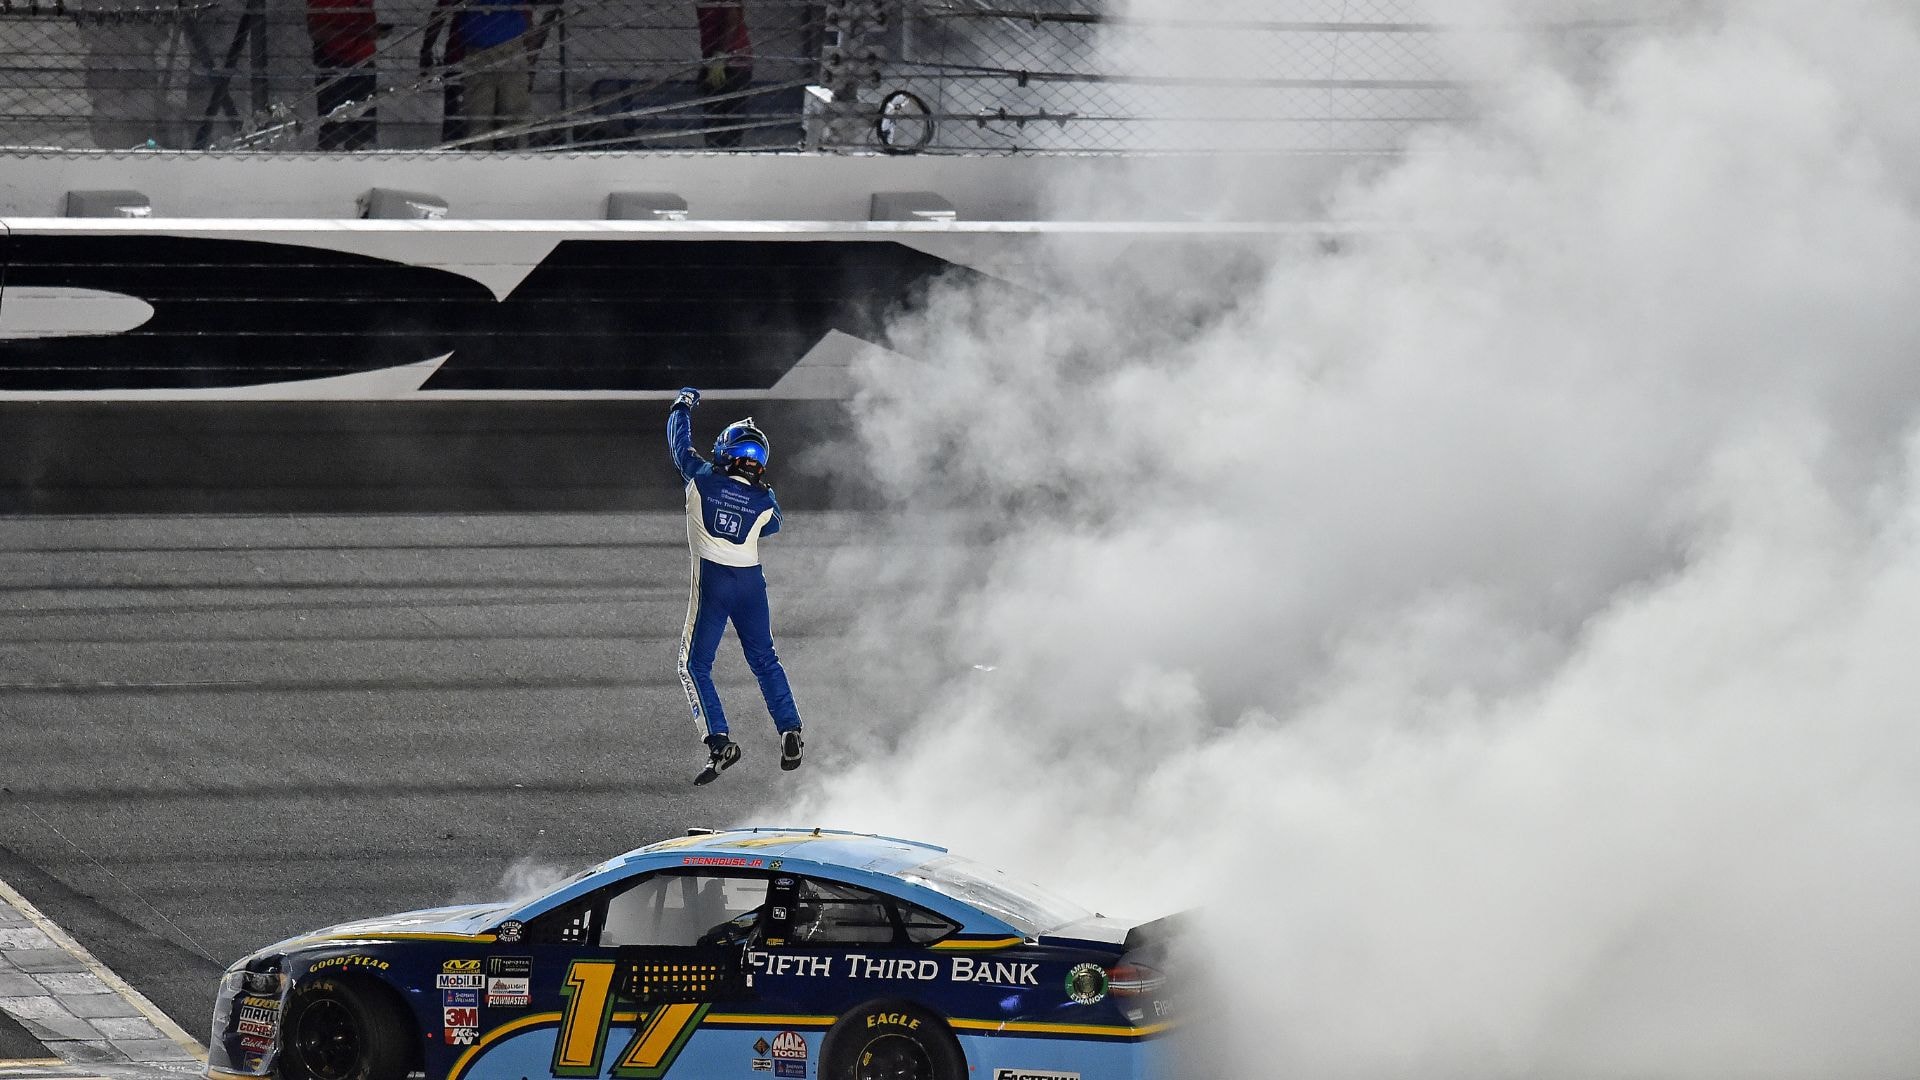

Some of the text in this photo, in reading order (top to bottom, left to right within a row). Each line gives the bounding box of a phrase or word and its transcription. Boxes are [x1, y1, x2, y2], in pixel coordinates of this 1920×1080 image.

[309, 954, 390, 973] GOODYEAR
[753, 952, 1039, 985] FIFTH THIRD BANK
[1070, 962, 1107, 978] AMERICAN
[440, 975, 470, 987] Mobil
[488, 996, 527, 1008] FLOWMASTER
[1070, 992, 1104, 1005] ETHANOL
[445, 1008, 477, 1026] 3M
[867, 1013, 921, 1030] EAGLE
[773, 1032, 806, 1051] MAC
[773, 1050, 806, 1058] TOOLS
